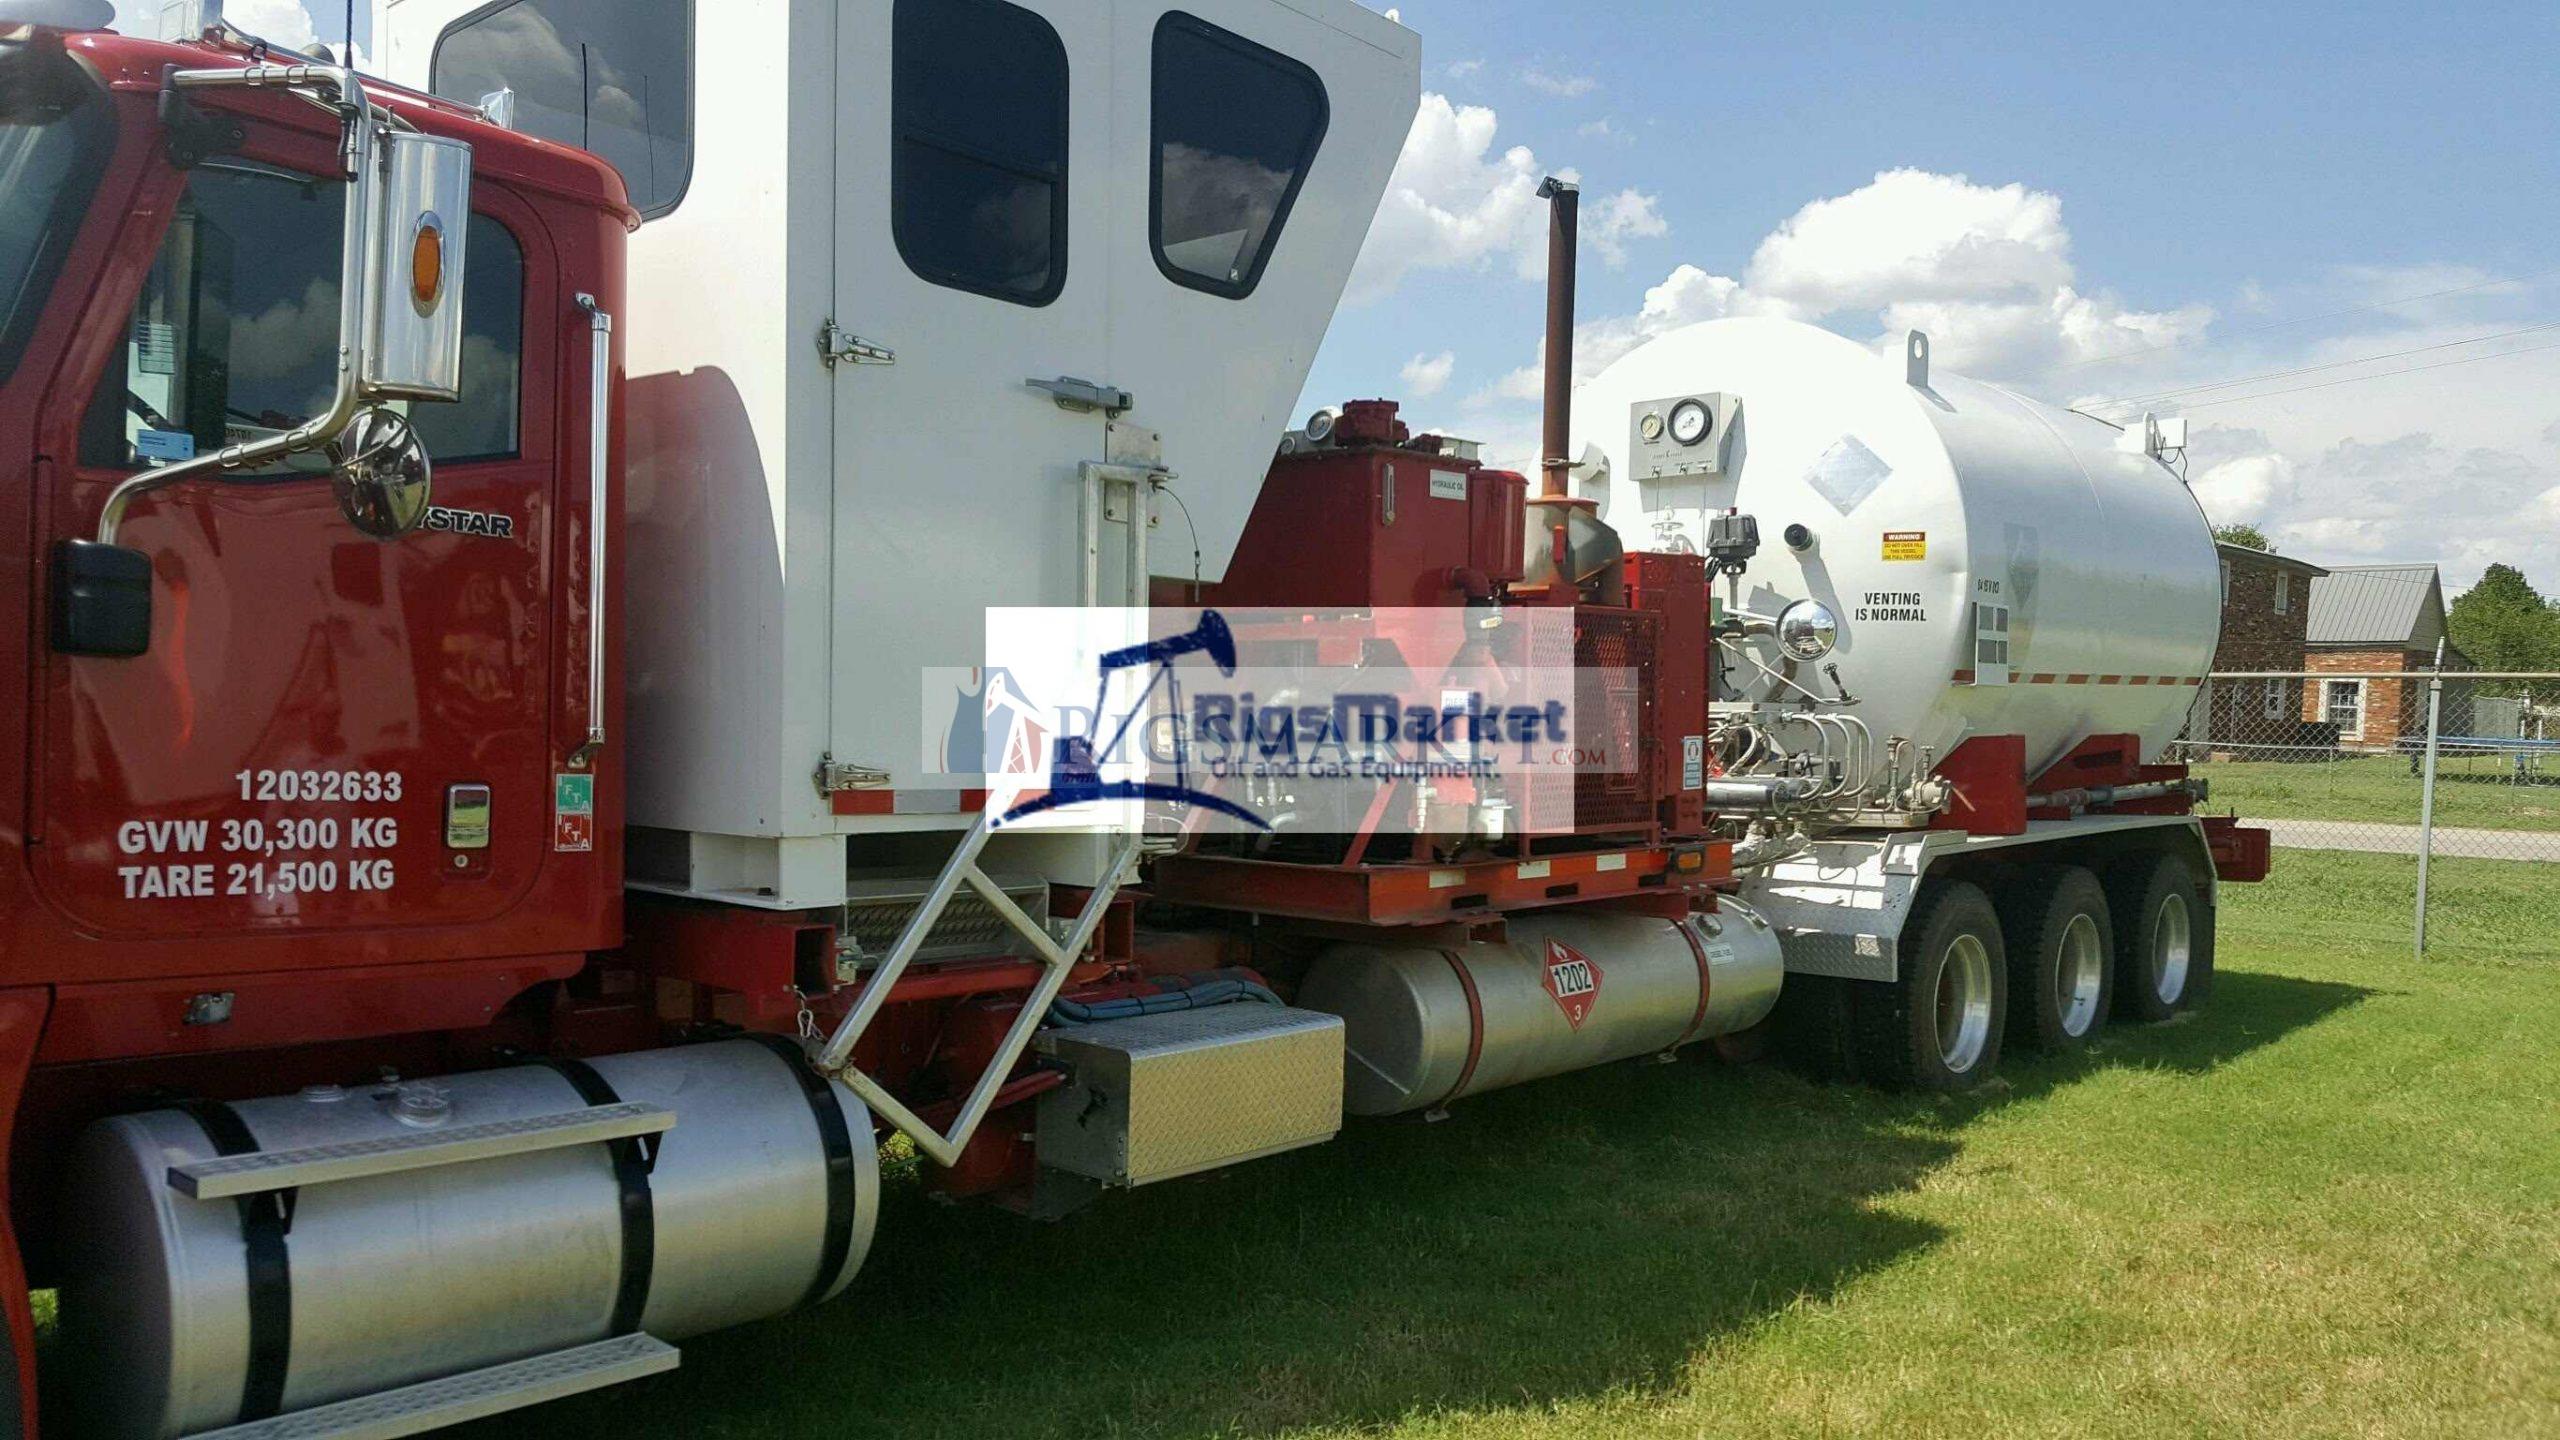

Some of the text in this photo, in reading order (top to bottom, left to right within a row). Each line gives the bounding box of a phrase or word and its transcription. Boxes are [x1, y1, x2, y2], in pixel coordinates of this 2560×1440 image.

[1864, 592, 1920, 605] VENTING
[1855, 608, 1927, 622] IS NORMAL
[235, 769, 402, 801] 12032633
[117, 817, 398, 857] GVW 30,300 KG
[117, 859, 394, 900] TARE 21,500 KG
[1554, 962, 1592, 994] 1202
[1574, 1004, 1582, 1021] 3
